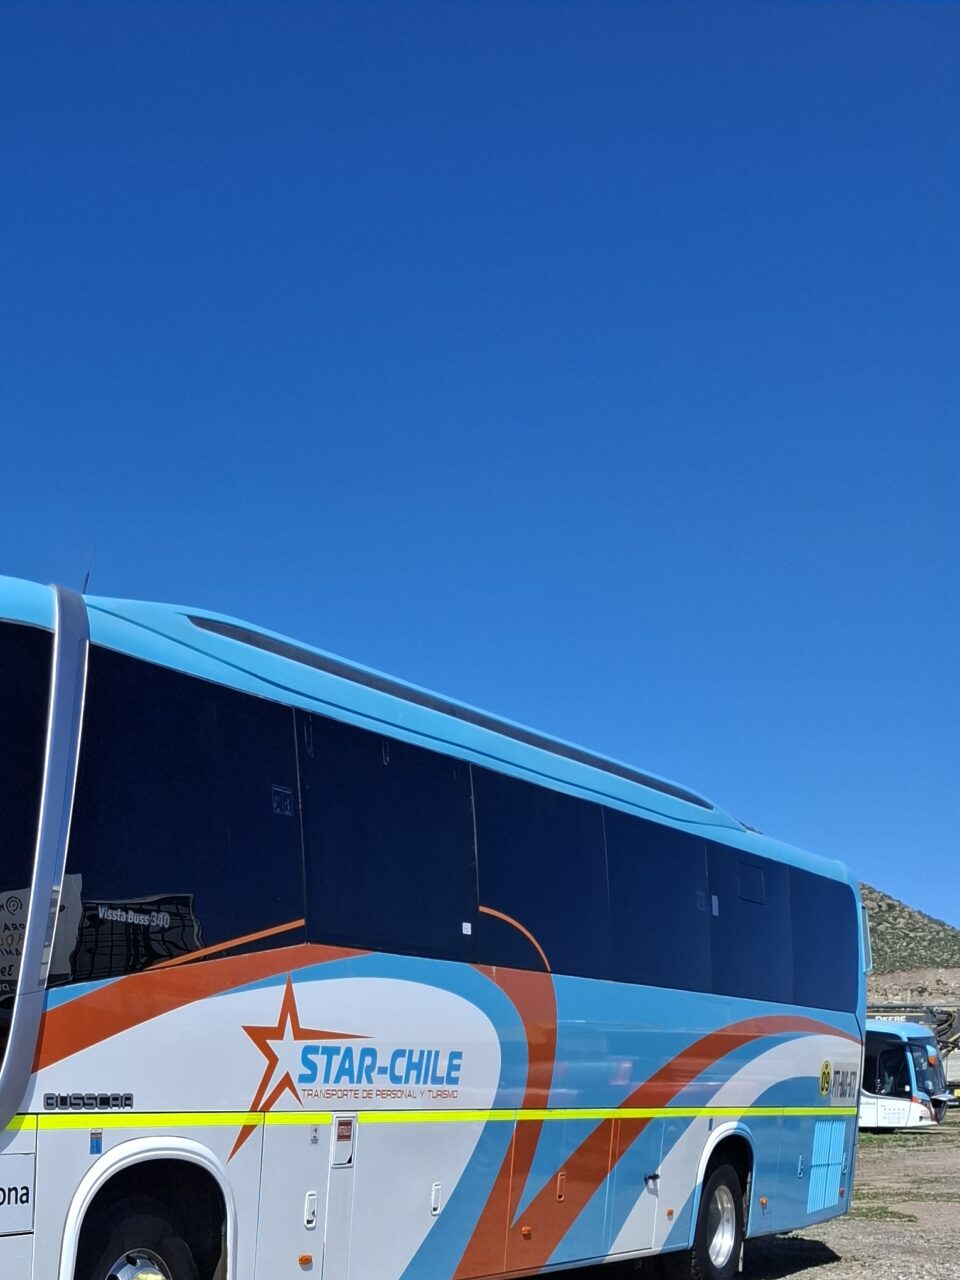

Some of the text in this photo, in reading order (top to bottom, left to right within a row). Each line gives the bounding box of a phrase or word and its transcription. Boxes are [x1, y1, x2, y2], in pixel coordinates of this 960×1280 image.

[97, 904, 171, 929] Vissta Buss 340
[298, 1044, 463, 1086] STAR-CHILE
[43, 1093, 134, 1110] BUSSCAR
[301, 1088, 458, 1099] TRANSPORTE DE PERSONAL Y TURISMO
